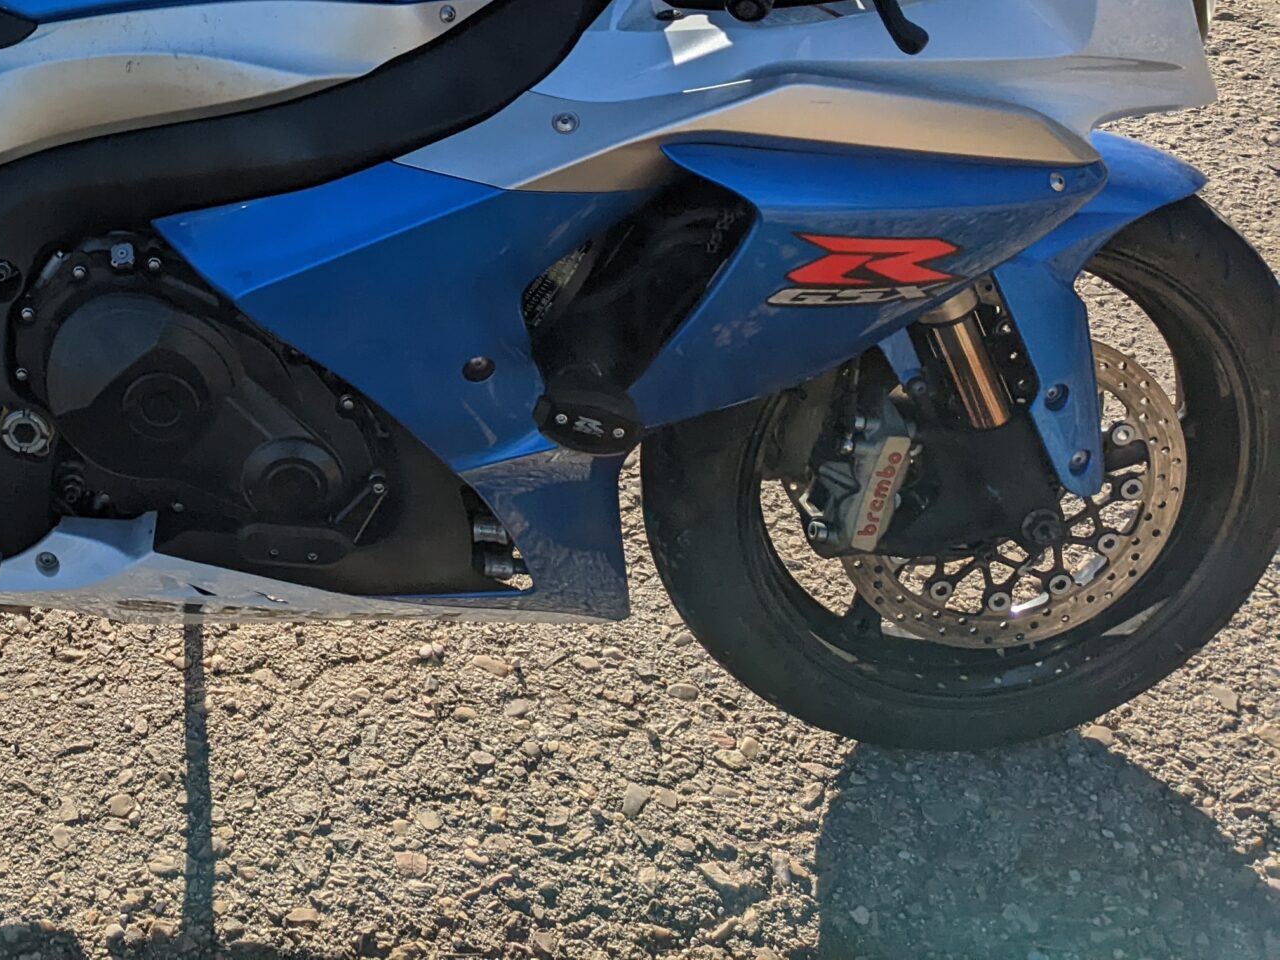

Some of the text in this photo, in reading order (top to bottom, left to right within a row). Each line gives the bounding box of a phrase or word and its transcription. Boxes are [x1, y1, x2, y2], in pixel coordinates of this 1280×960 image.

[785, 231, 966, 286] R
[768, 283, 952, 306] GSX
[857, 451, 902, 536] brembo
